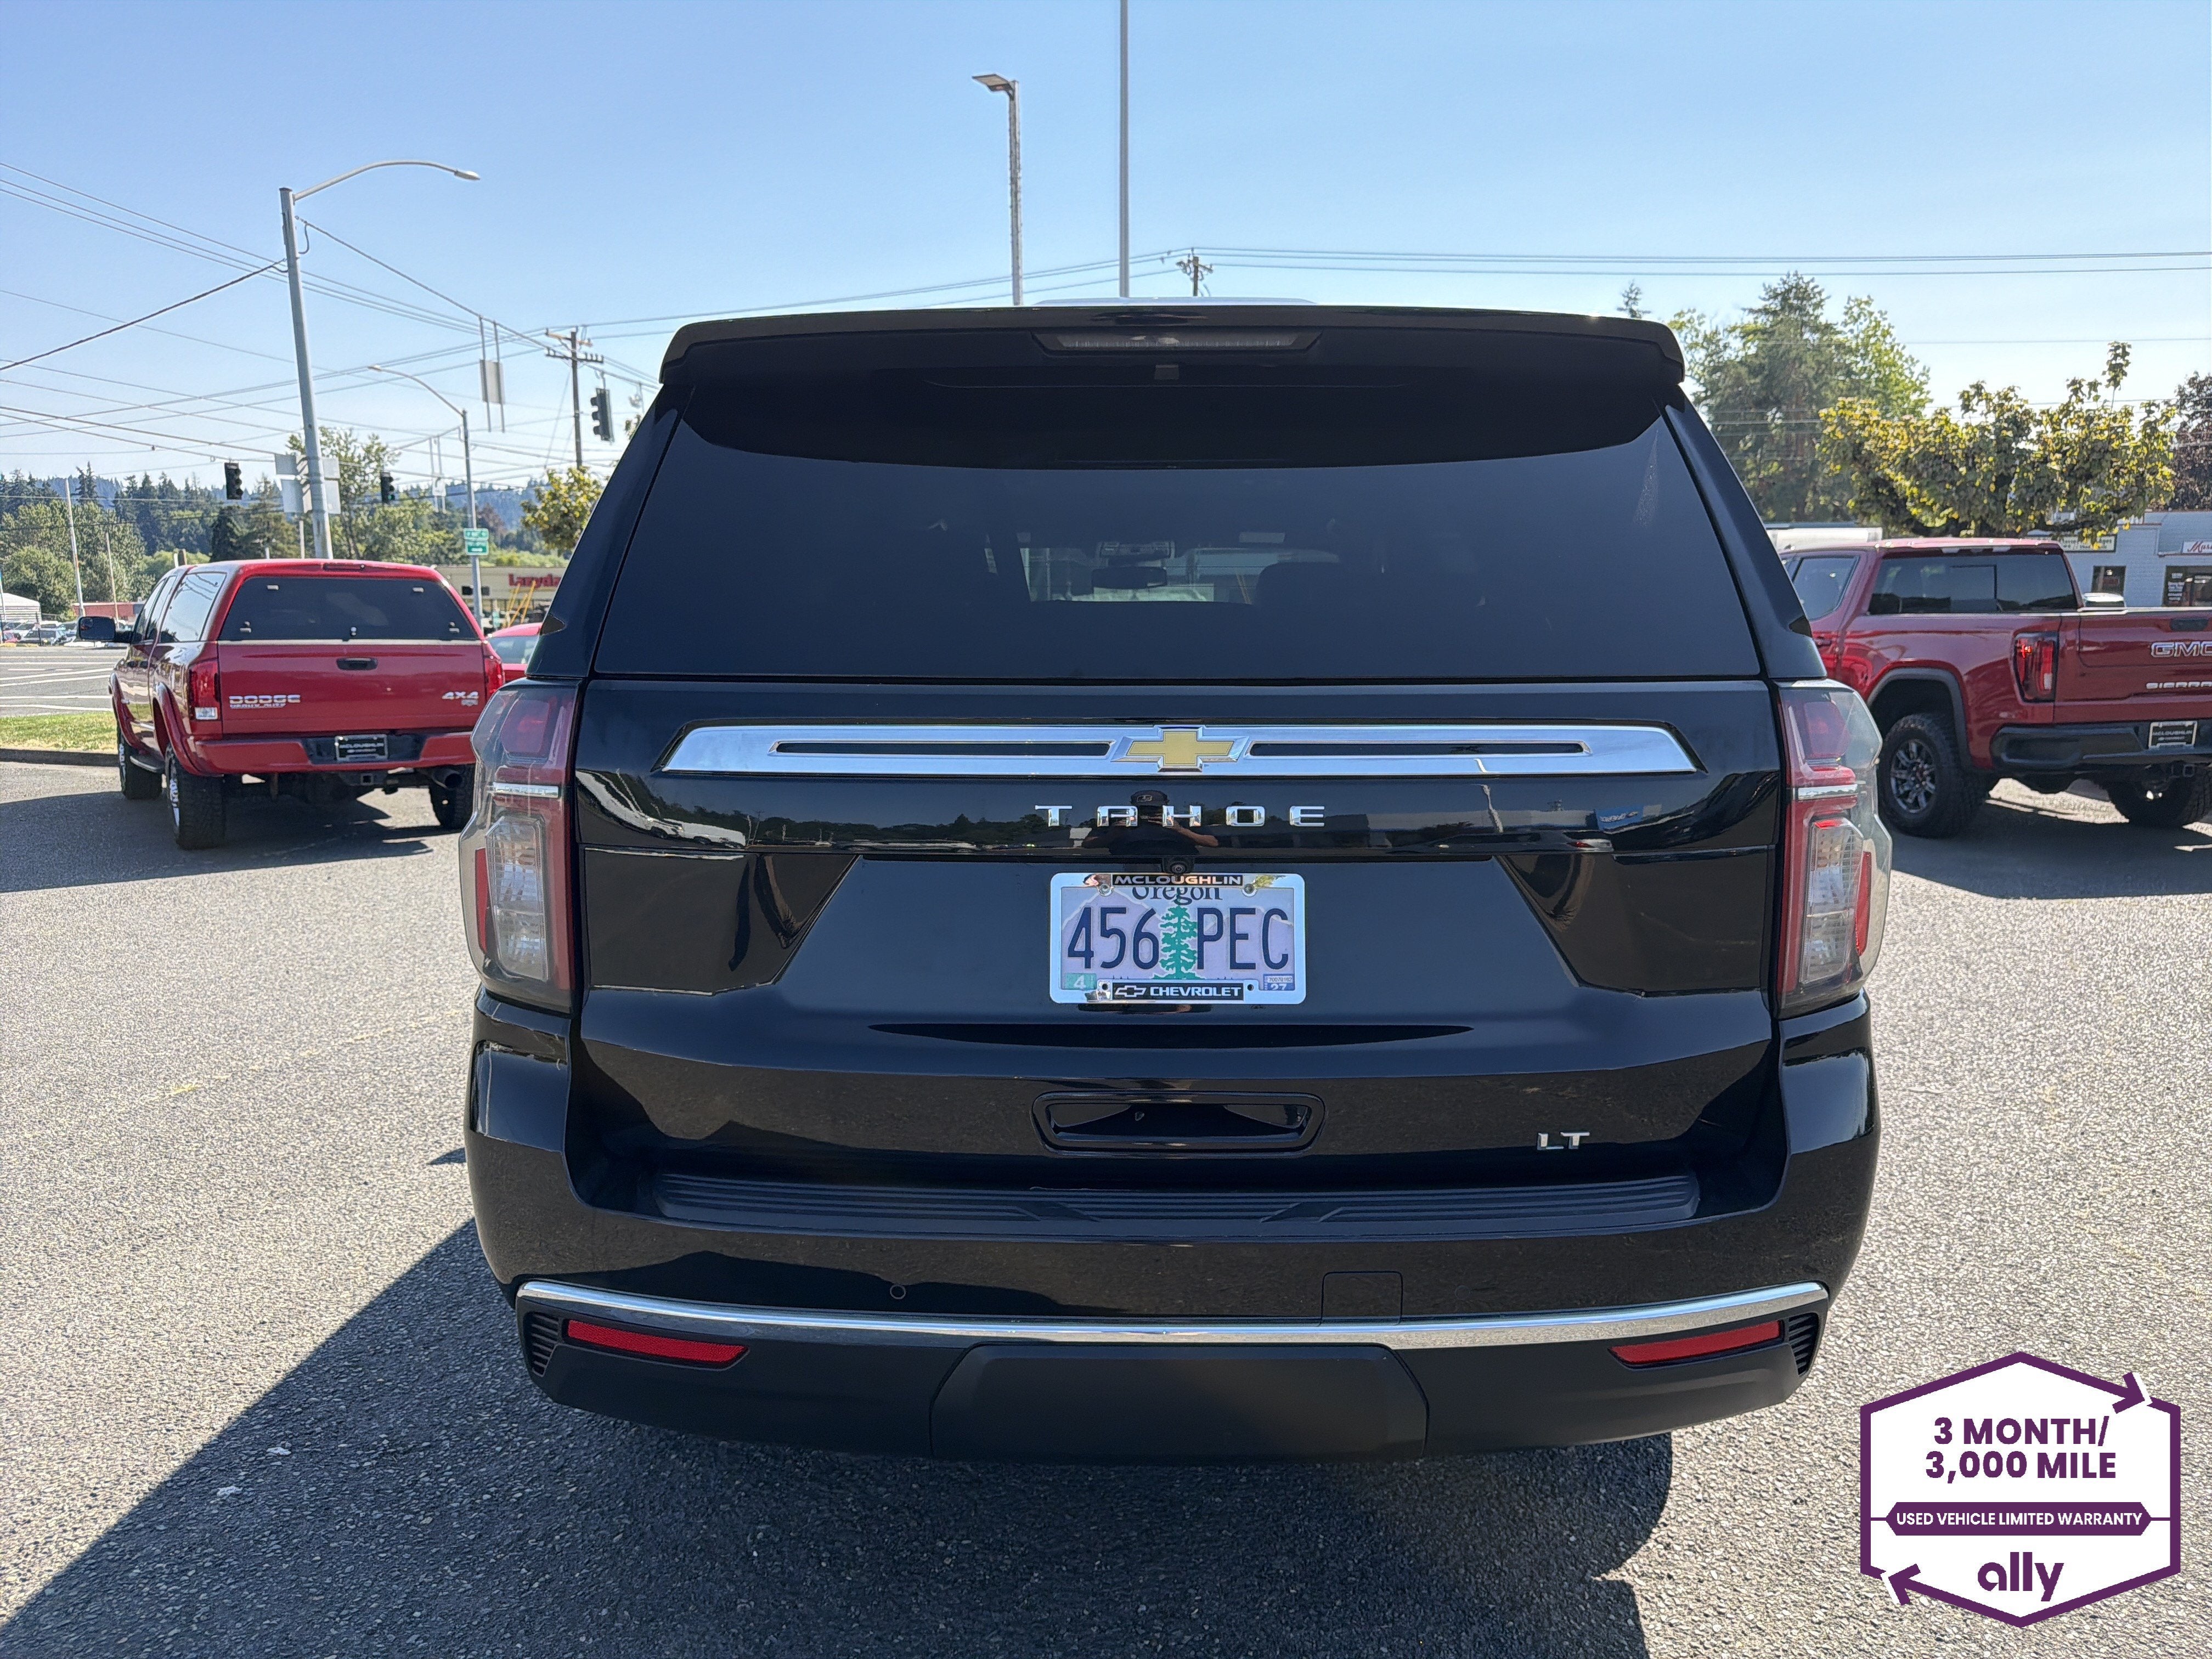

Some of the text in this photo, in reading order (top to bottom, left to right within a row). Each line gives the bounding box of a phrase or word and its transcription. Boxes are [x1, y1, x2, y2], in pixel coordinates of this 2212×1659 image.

[228, 694, 301, 704] DODGE
[1035, 805, 1325, 827] TAHOE
[1114, 875, 1242, 885] MCLOUGHLIN
[1132, 886, 1223, 906] Oregon
[1067, 907, 1289, 970] 456 PEC
[1073, 975, 1087, 989] 4
[1150, 986, 1242, 998] CHEVROLET
[1537, 1132, 1590, 1150] LT
